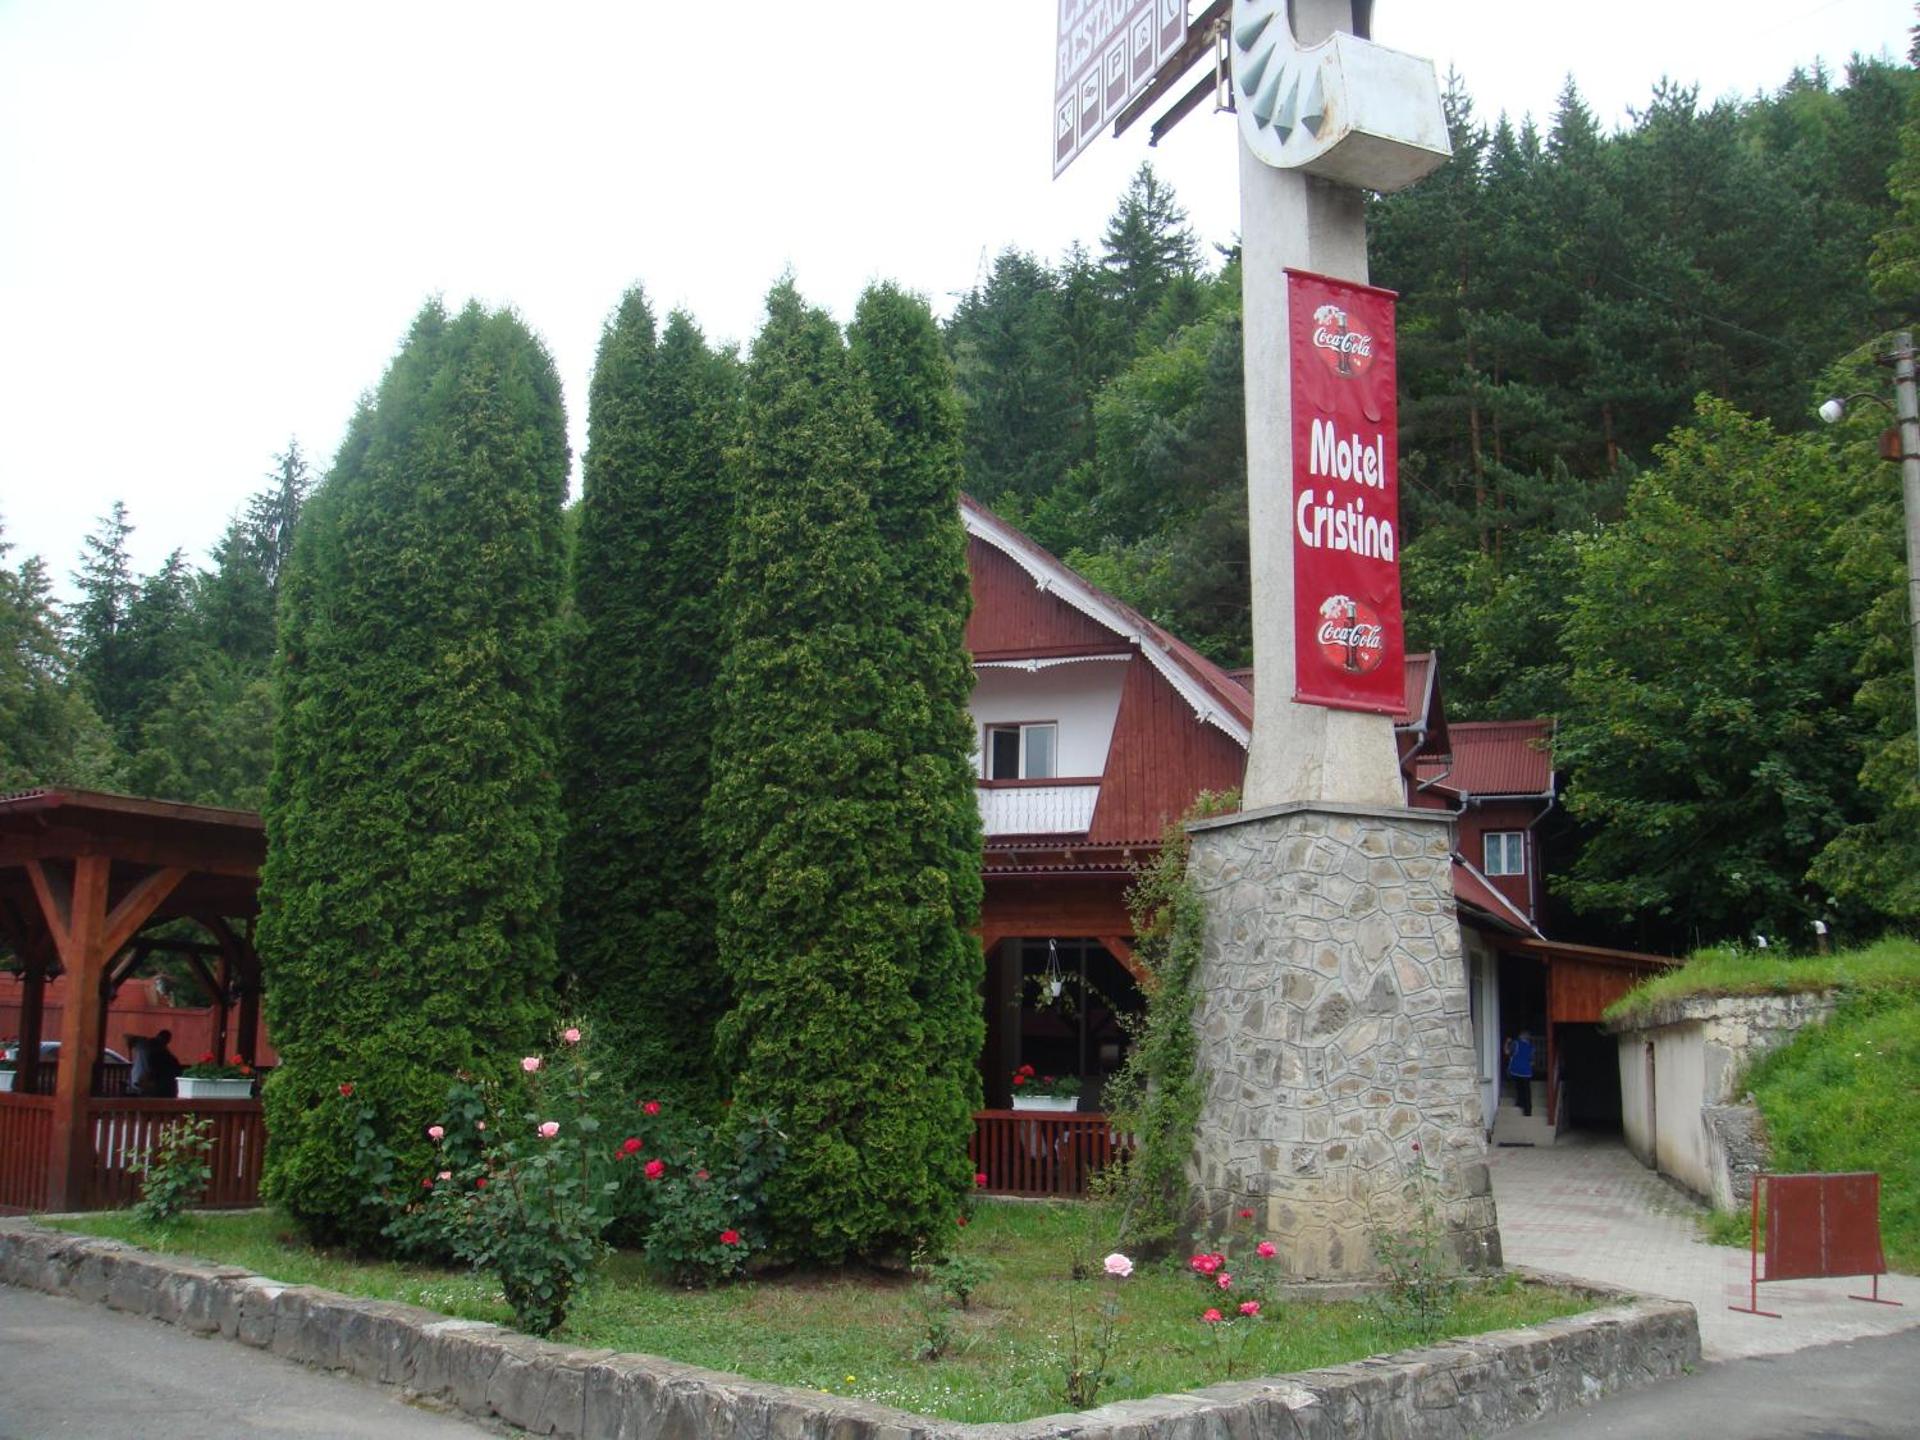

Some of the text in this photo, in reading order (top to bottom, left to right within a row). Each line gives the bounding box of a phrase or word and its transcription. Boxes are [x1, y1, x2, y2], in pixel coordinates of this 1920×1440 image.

[1312, 326, 1372, 357] Coca-Cola
[1310, 418, 1385, 490] Motel
[1297, 489, 1394, 563] Cristina
[1317, 620, 1382, 649] Coca-Cola
